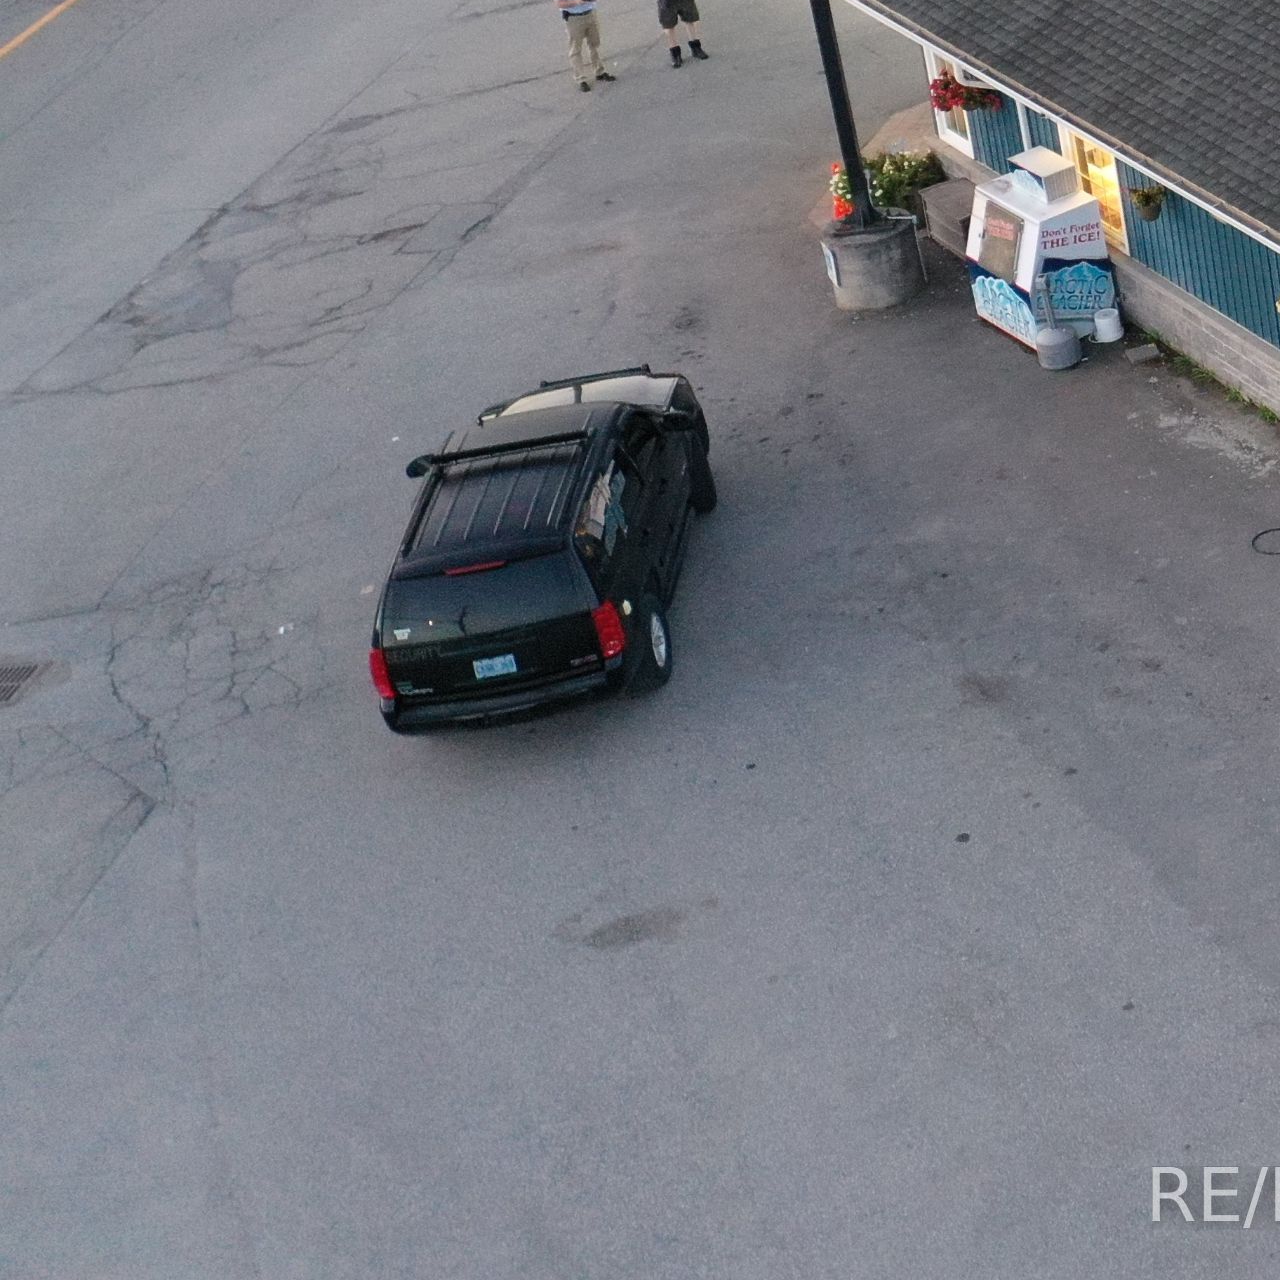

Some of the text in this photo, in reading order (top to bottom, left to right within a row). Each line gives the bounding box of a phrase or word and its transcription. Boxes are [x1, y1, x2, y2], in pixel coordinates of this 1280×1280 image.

[1041, 222, 1100, 239] Don't Forget
[1041, 231, 1100, 250] THE ICE!
[1042, 275, 1108, 295] RCTIC
